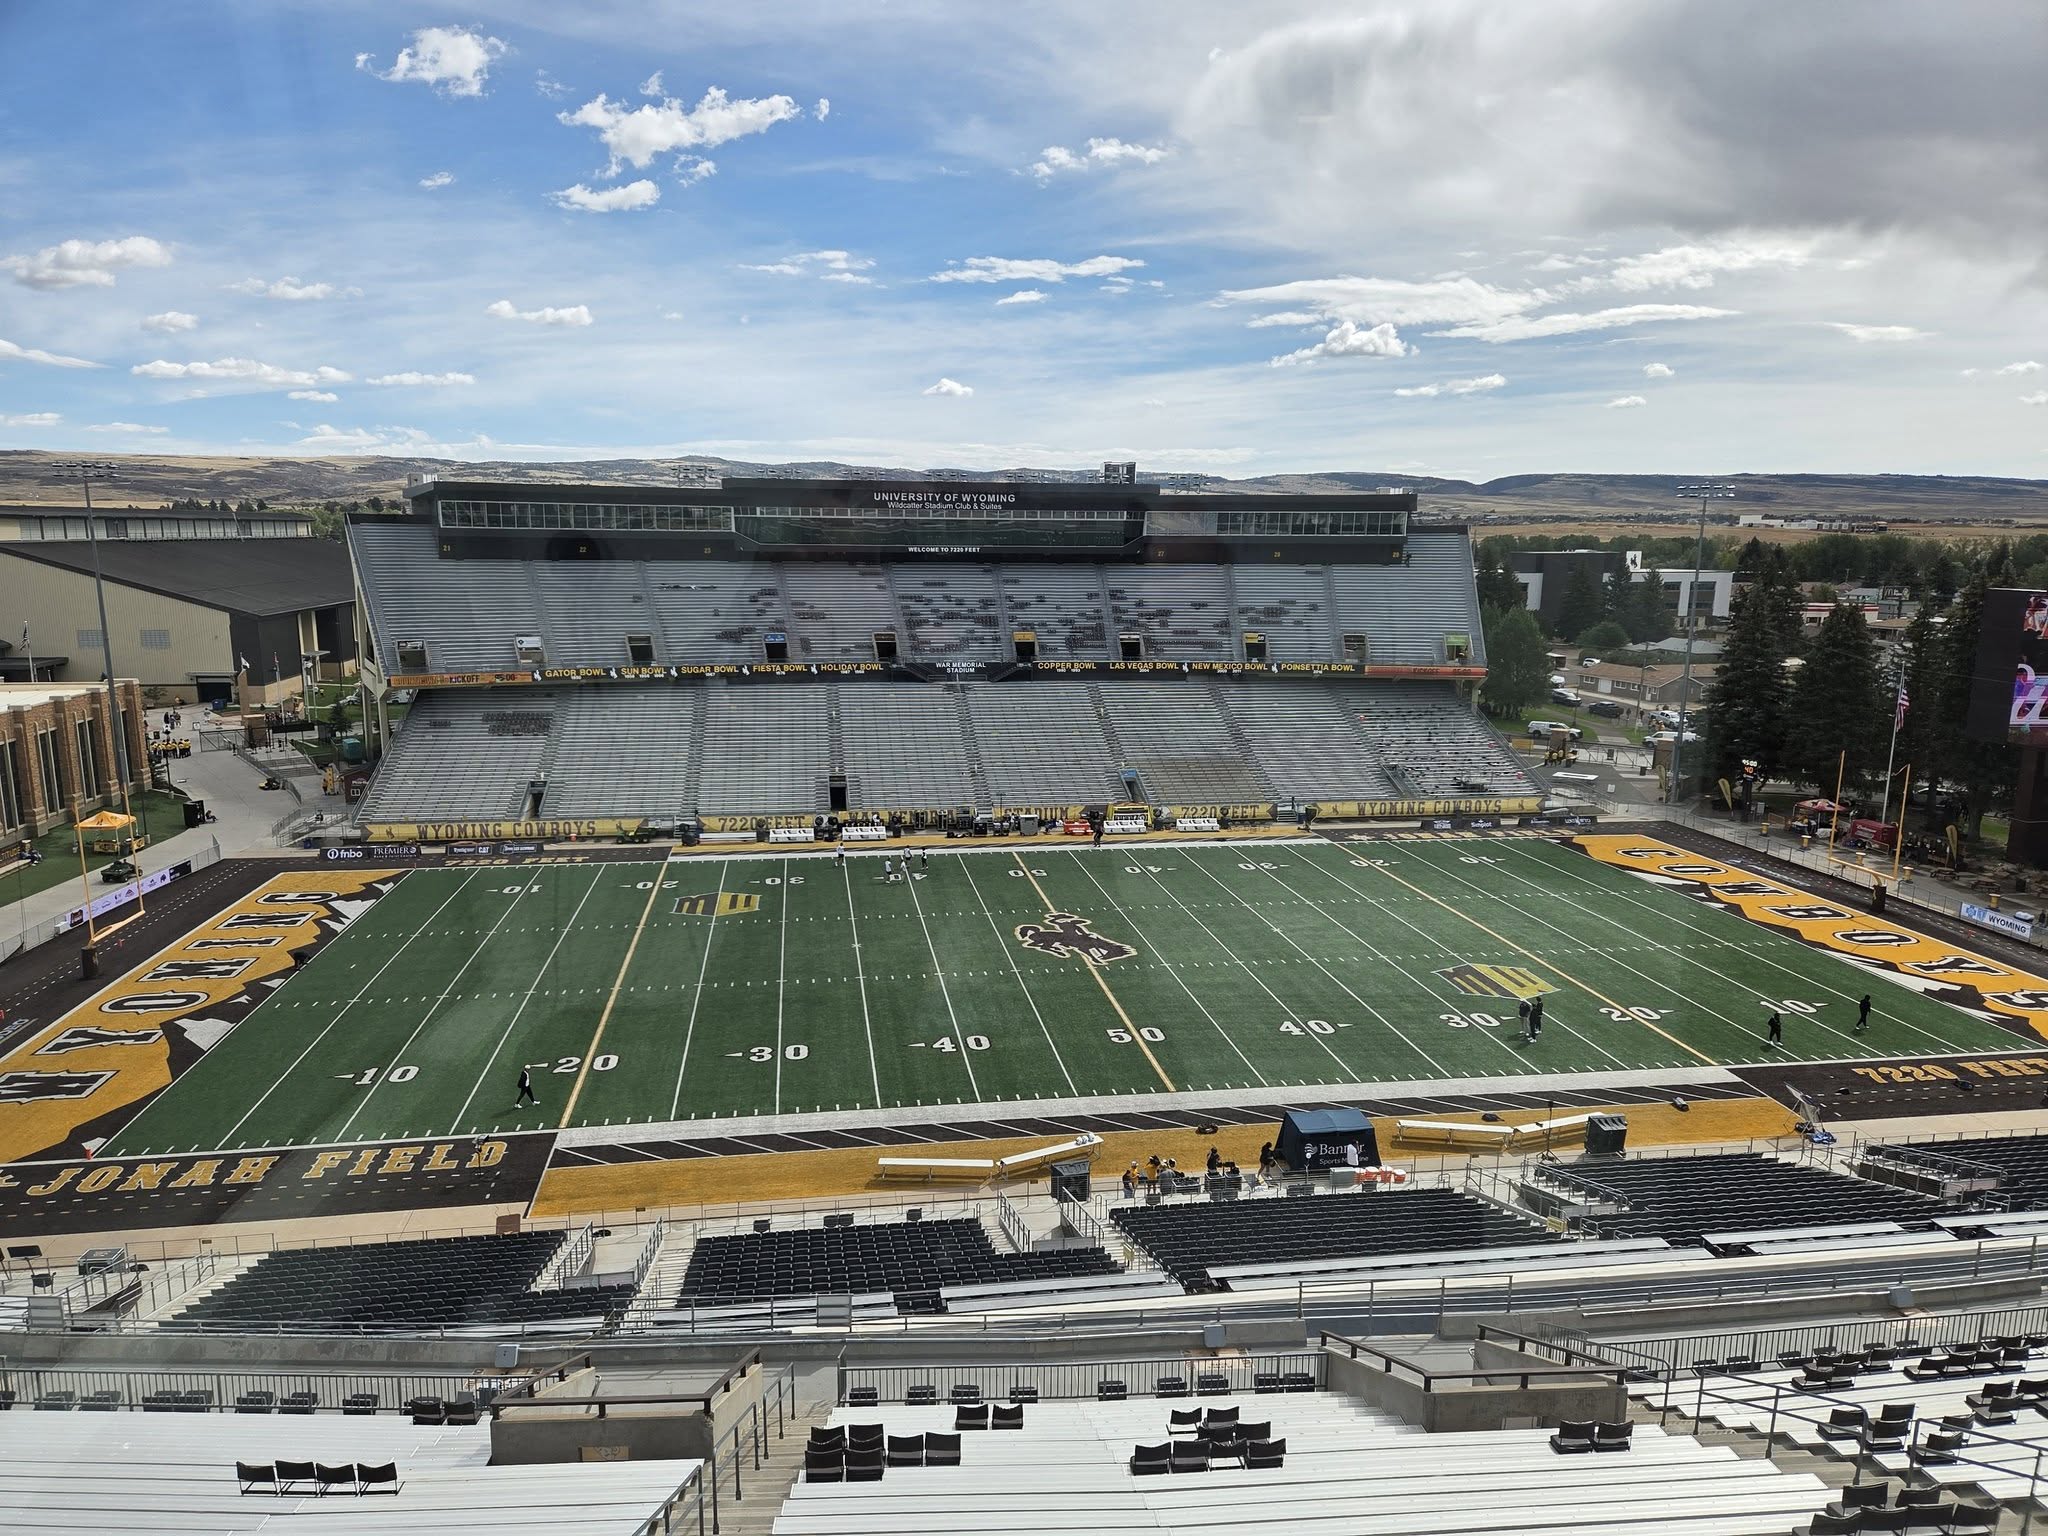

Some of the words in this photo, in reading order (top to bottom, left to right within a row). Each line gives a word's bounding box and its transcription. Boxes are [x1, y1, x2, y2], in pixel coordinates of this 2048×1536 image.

[874, 492, 941, 501] UNIVERSITY
[944, 493, 959, 502] OF
[961, 494, 1016, 503] WYOMING
[621, 667, 639, 675] SUN
[641, 667, 667, 675] BOWL
[681, 666, 711, 674] SUGAR
[714, 665, 739, 673] BOWL
[783, 664, 807, 672] BOWL
[860, 663, 883, 671] BOWL
[545, 669, 577, 678] GATOR
[579, 668, 606, 676] BOWL
[449, 674, 480, 684] KICKOFF
[1181, 806, 1217, 819] 7220
[1221, 806, 1260, 819] EET
[1357, 801, 1426, 816] WYOMING
[1433, 799, 1502, 814] COWBOYS
[718, 816, 757, 832] 7220
[764, 815, 806, 829] FEET
[1471, 821, 1493, 829] Simplot
[416, 823, 502, 840] WYOMING
[513, 820, 597, 838] COWBOYS
[340, 849, 363, 859] fnbo
[374, 847, 409, 855] PREMIER
[478, 846, 490, 854] CAT
[444, 858, 509, 867] 7220
[522, 856, 590, 865] FEET
[1349, 859, 1390, 868] 20
[1458, 855, 1499, 864] 10
[1008, 868, 1048, 877] 50
[1124, 865, 1163, 874] 40
[636, 880, 680, 890] 20
[765, 876, 806, 885] 30
[502, 884, 543, 895] 10
[1616, 847, 2048, 1011] COWBOYS
[1988, 914, 2027, 934] WYOMING
[0, 890, 341, 1105] WYOMING
[1759, 999, 1819, 1016] 10
[1599, 1005, 1662, 1023] 20
[1438, 1011, 1501, 1030] 30
[1278, 1018, 1337, 1036] 40
[1106, 1026, 1167, 1044] 50
[931, 1034, 991, 1053] 40
[748, 1043, 810, 1063] 30
[551, 1053, 620, 1074] 20
[354, 1064, 420, 1086] 10
[1851, 1064, 1961, 1084] 7220
[1957, 1058, 2048, 1078] FEET
[1319, 1143, 1365, 1156] Bannr
[1320, 1158, 1341, 1166] Sports
[26, 1155, 281, 1196] JONAH
[302, 1140, 510, 1180] FIELD
